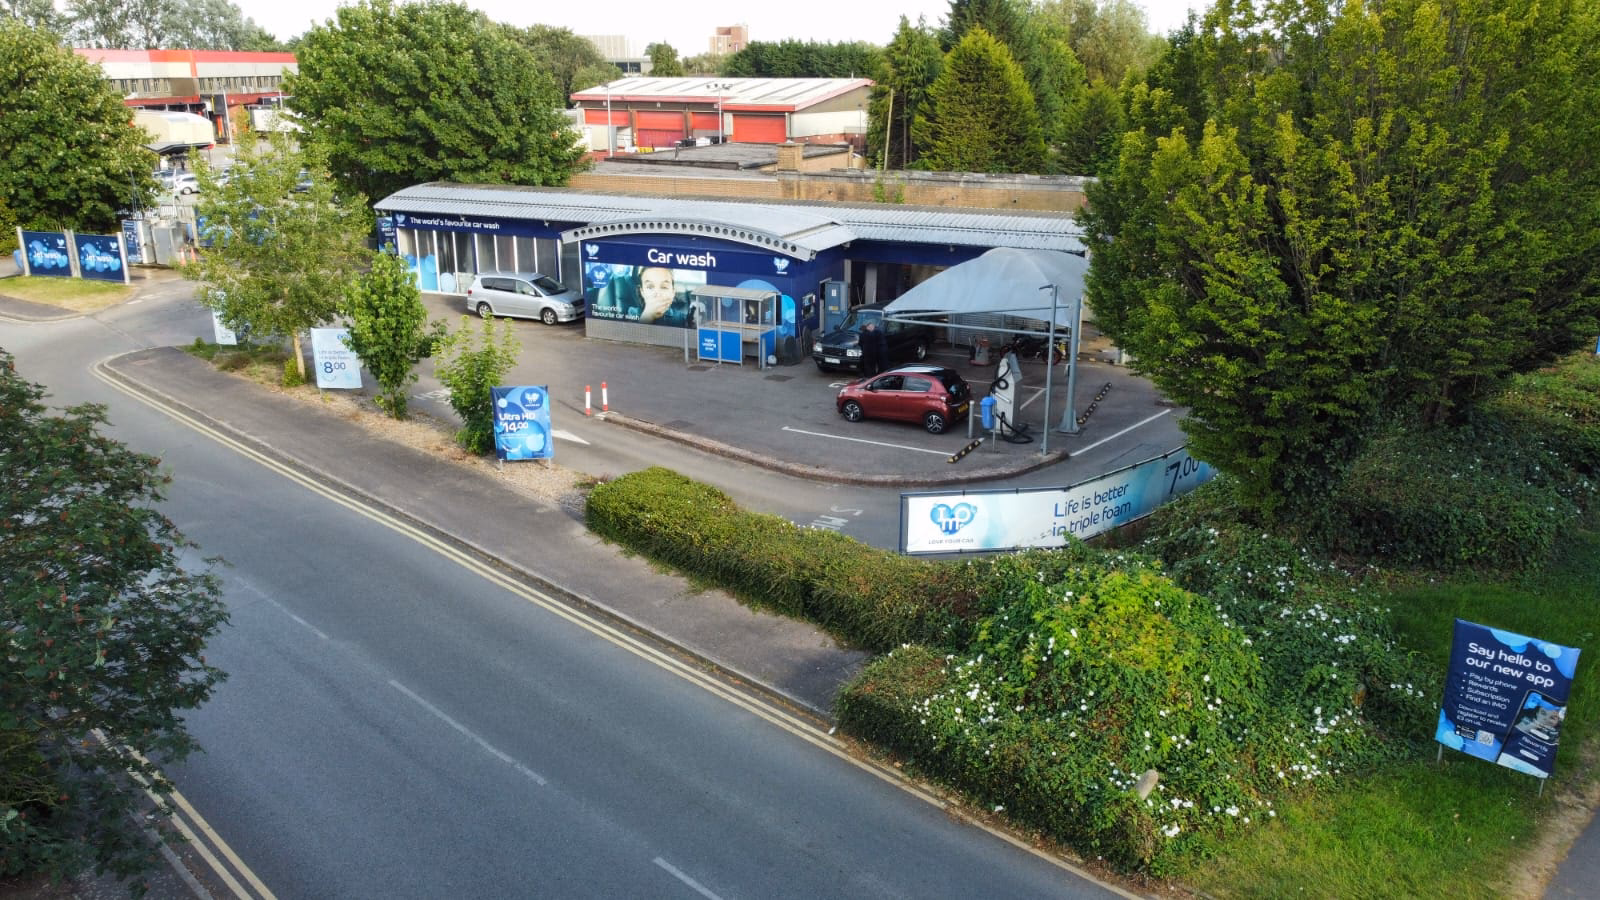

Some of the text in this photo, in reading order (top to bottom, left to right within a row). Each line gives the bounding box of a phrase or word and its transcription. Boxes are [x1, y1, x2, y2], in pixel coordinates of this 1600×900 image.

[410, 216, 421, 224] The
[444, 219, 472, 227] favourite
[647, 248, 716, 267] Car wash
[498, 412, 520, 420] Ultra
[1054, 484, 1129, 517] Life is better
[1052, 500, 1131, 536] in triple foam
[1468, 642, 1552, 672] Say hello to
[1466, 657, 1554, 688] our new app
[1470, 672, 1518, 690] Pay by phone
[1468, 679, 1498, 692] Rewards
[1466, 694, 1481, 703] Find
[1492, 702, 1507, 710] IMO
[1467, 687, 1510, 703] Subscription
